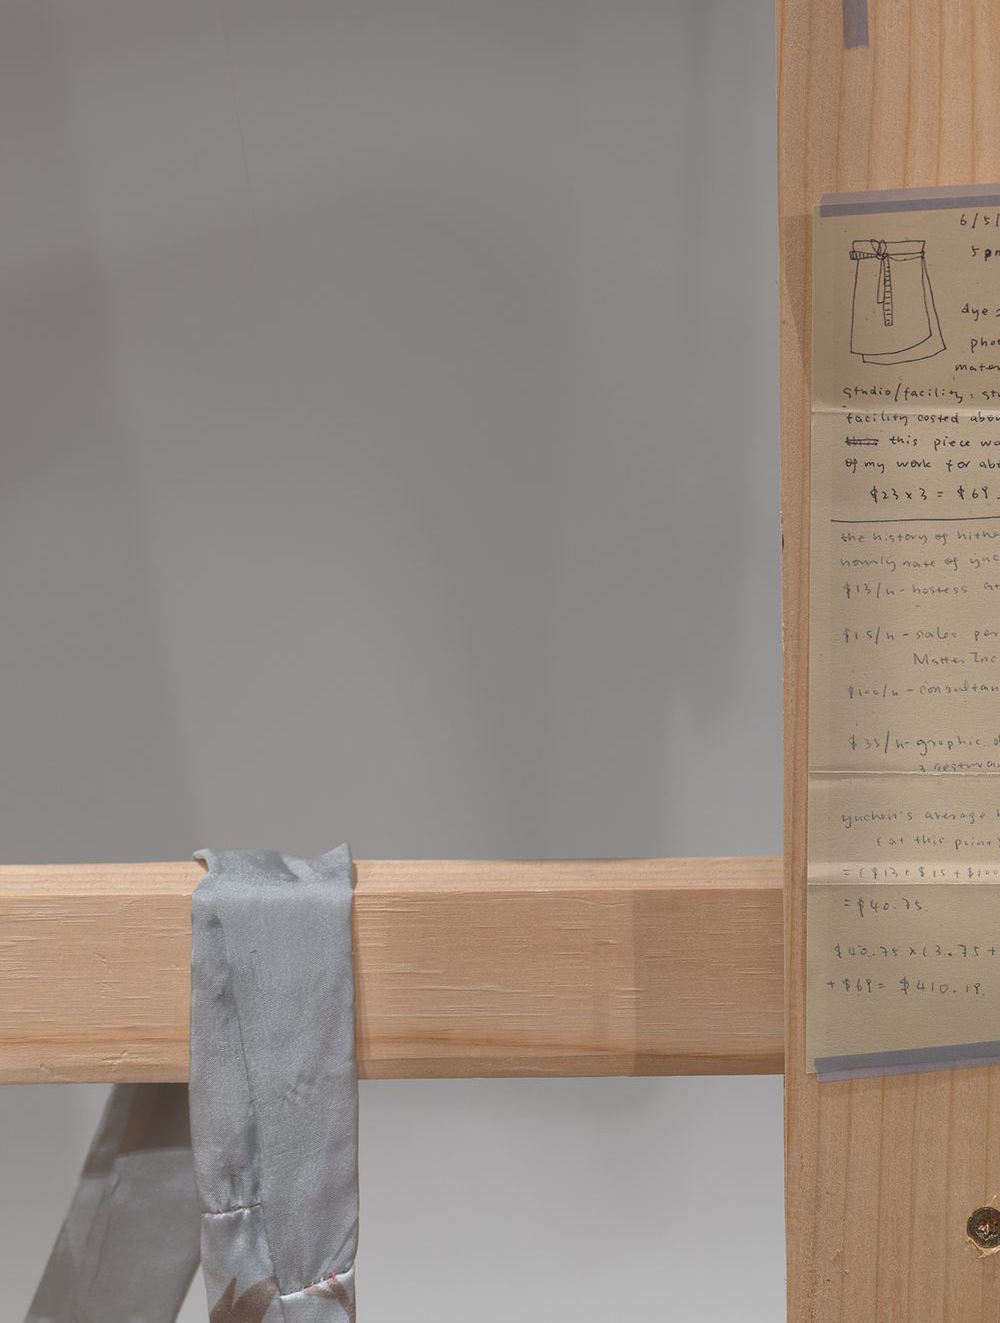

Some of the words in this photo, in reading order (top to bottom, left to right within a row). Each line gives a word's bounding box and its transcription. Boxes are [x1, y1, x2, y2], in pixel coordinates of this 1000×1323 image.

[961, 303, 988, 322] dye
[846, 412, 907, 426] facility
[918, 414, 959, 424] costed
[889, 435, 917, 446] this
[934, 438, 970, 451] piece
[845, 458, 858, 473] of
[864, 462, 884, 474] my
[897, 459, 931, 468] work
[946, 460, 971, 472] for
[841, 532, 864, 543] the
[873, 533, 928, 545] history
[935, 533, 948, 545] of
[903, 559, 935, 569] rate
[944, 557, 958, 571] of
[912, 585, 967, 595] hostess
[984, 581, 1000, 591] at
[914, 835, 944, 845] this
